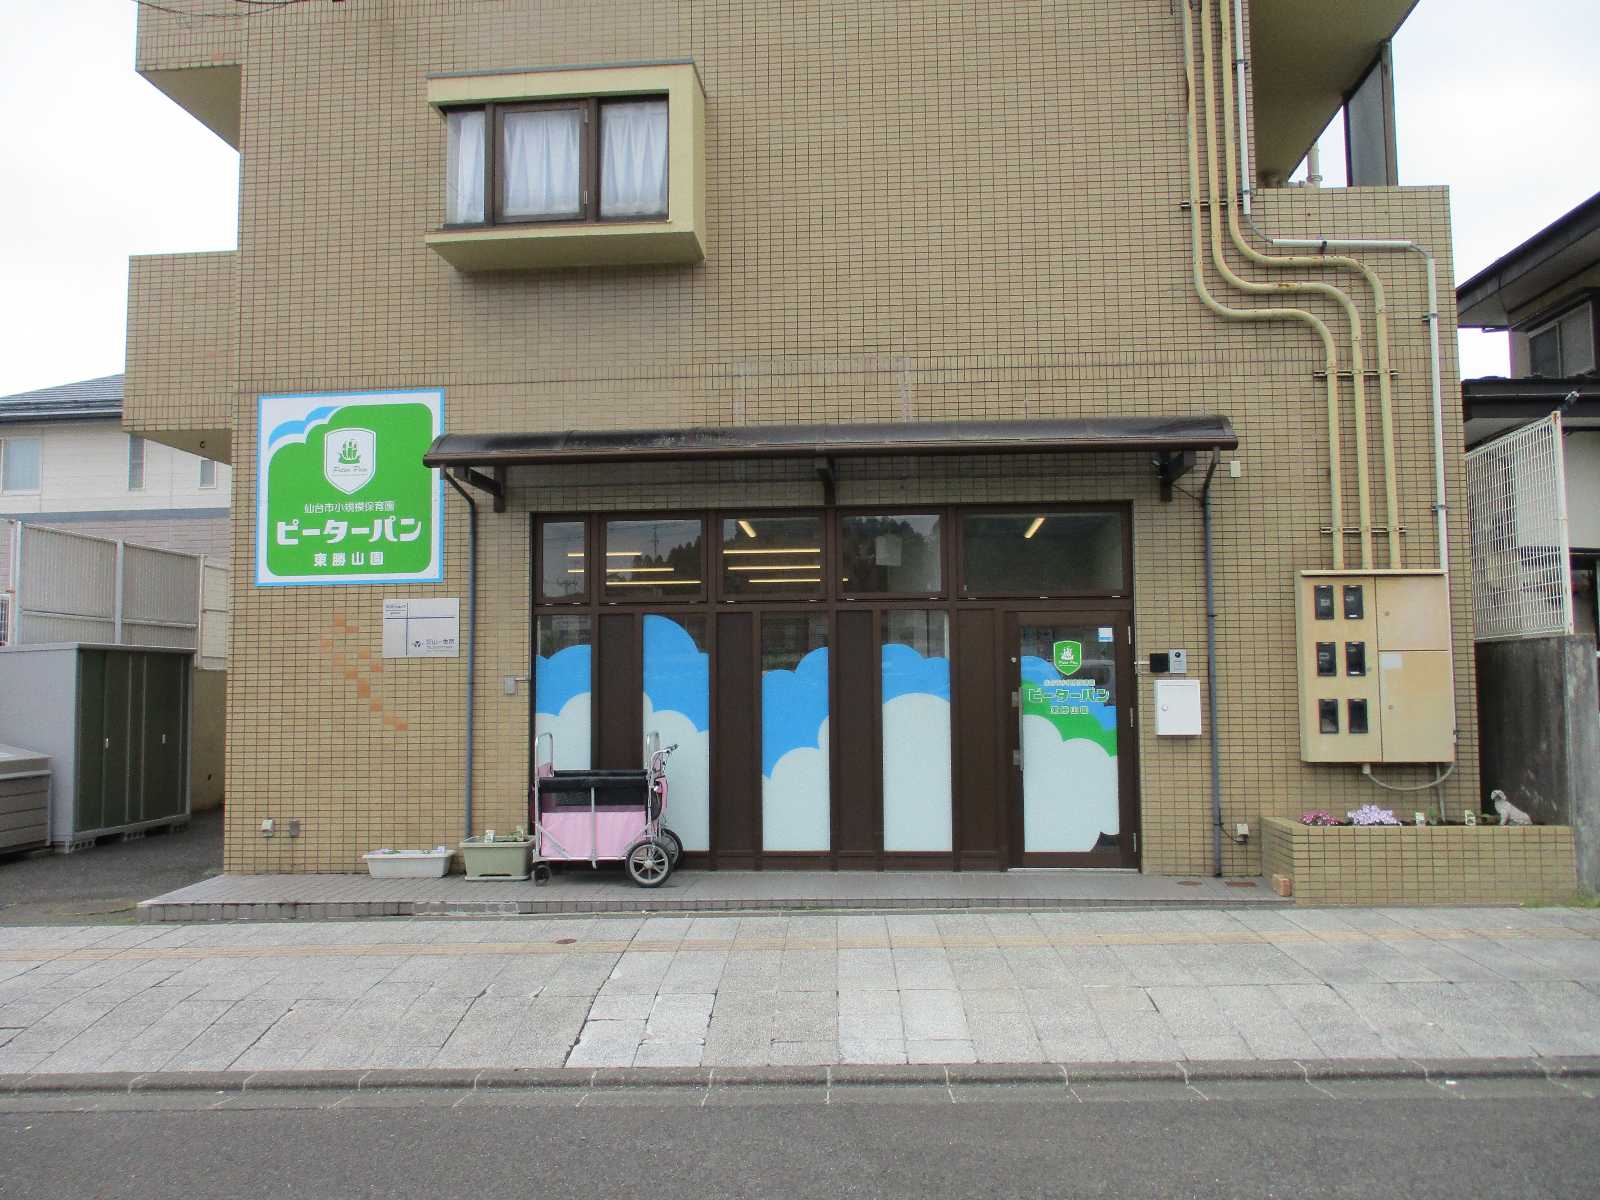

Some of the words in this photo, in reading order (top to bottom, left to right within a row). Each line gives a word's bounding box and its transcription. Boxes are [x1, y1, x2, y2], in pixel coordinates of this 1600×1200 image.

[277, 515, 422, 545] ピーターパン
[314, 552, 384, 567] 東勝山園
[1028, 687, 1110, 703] ピーターパン
